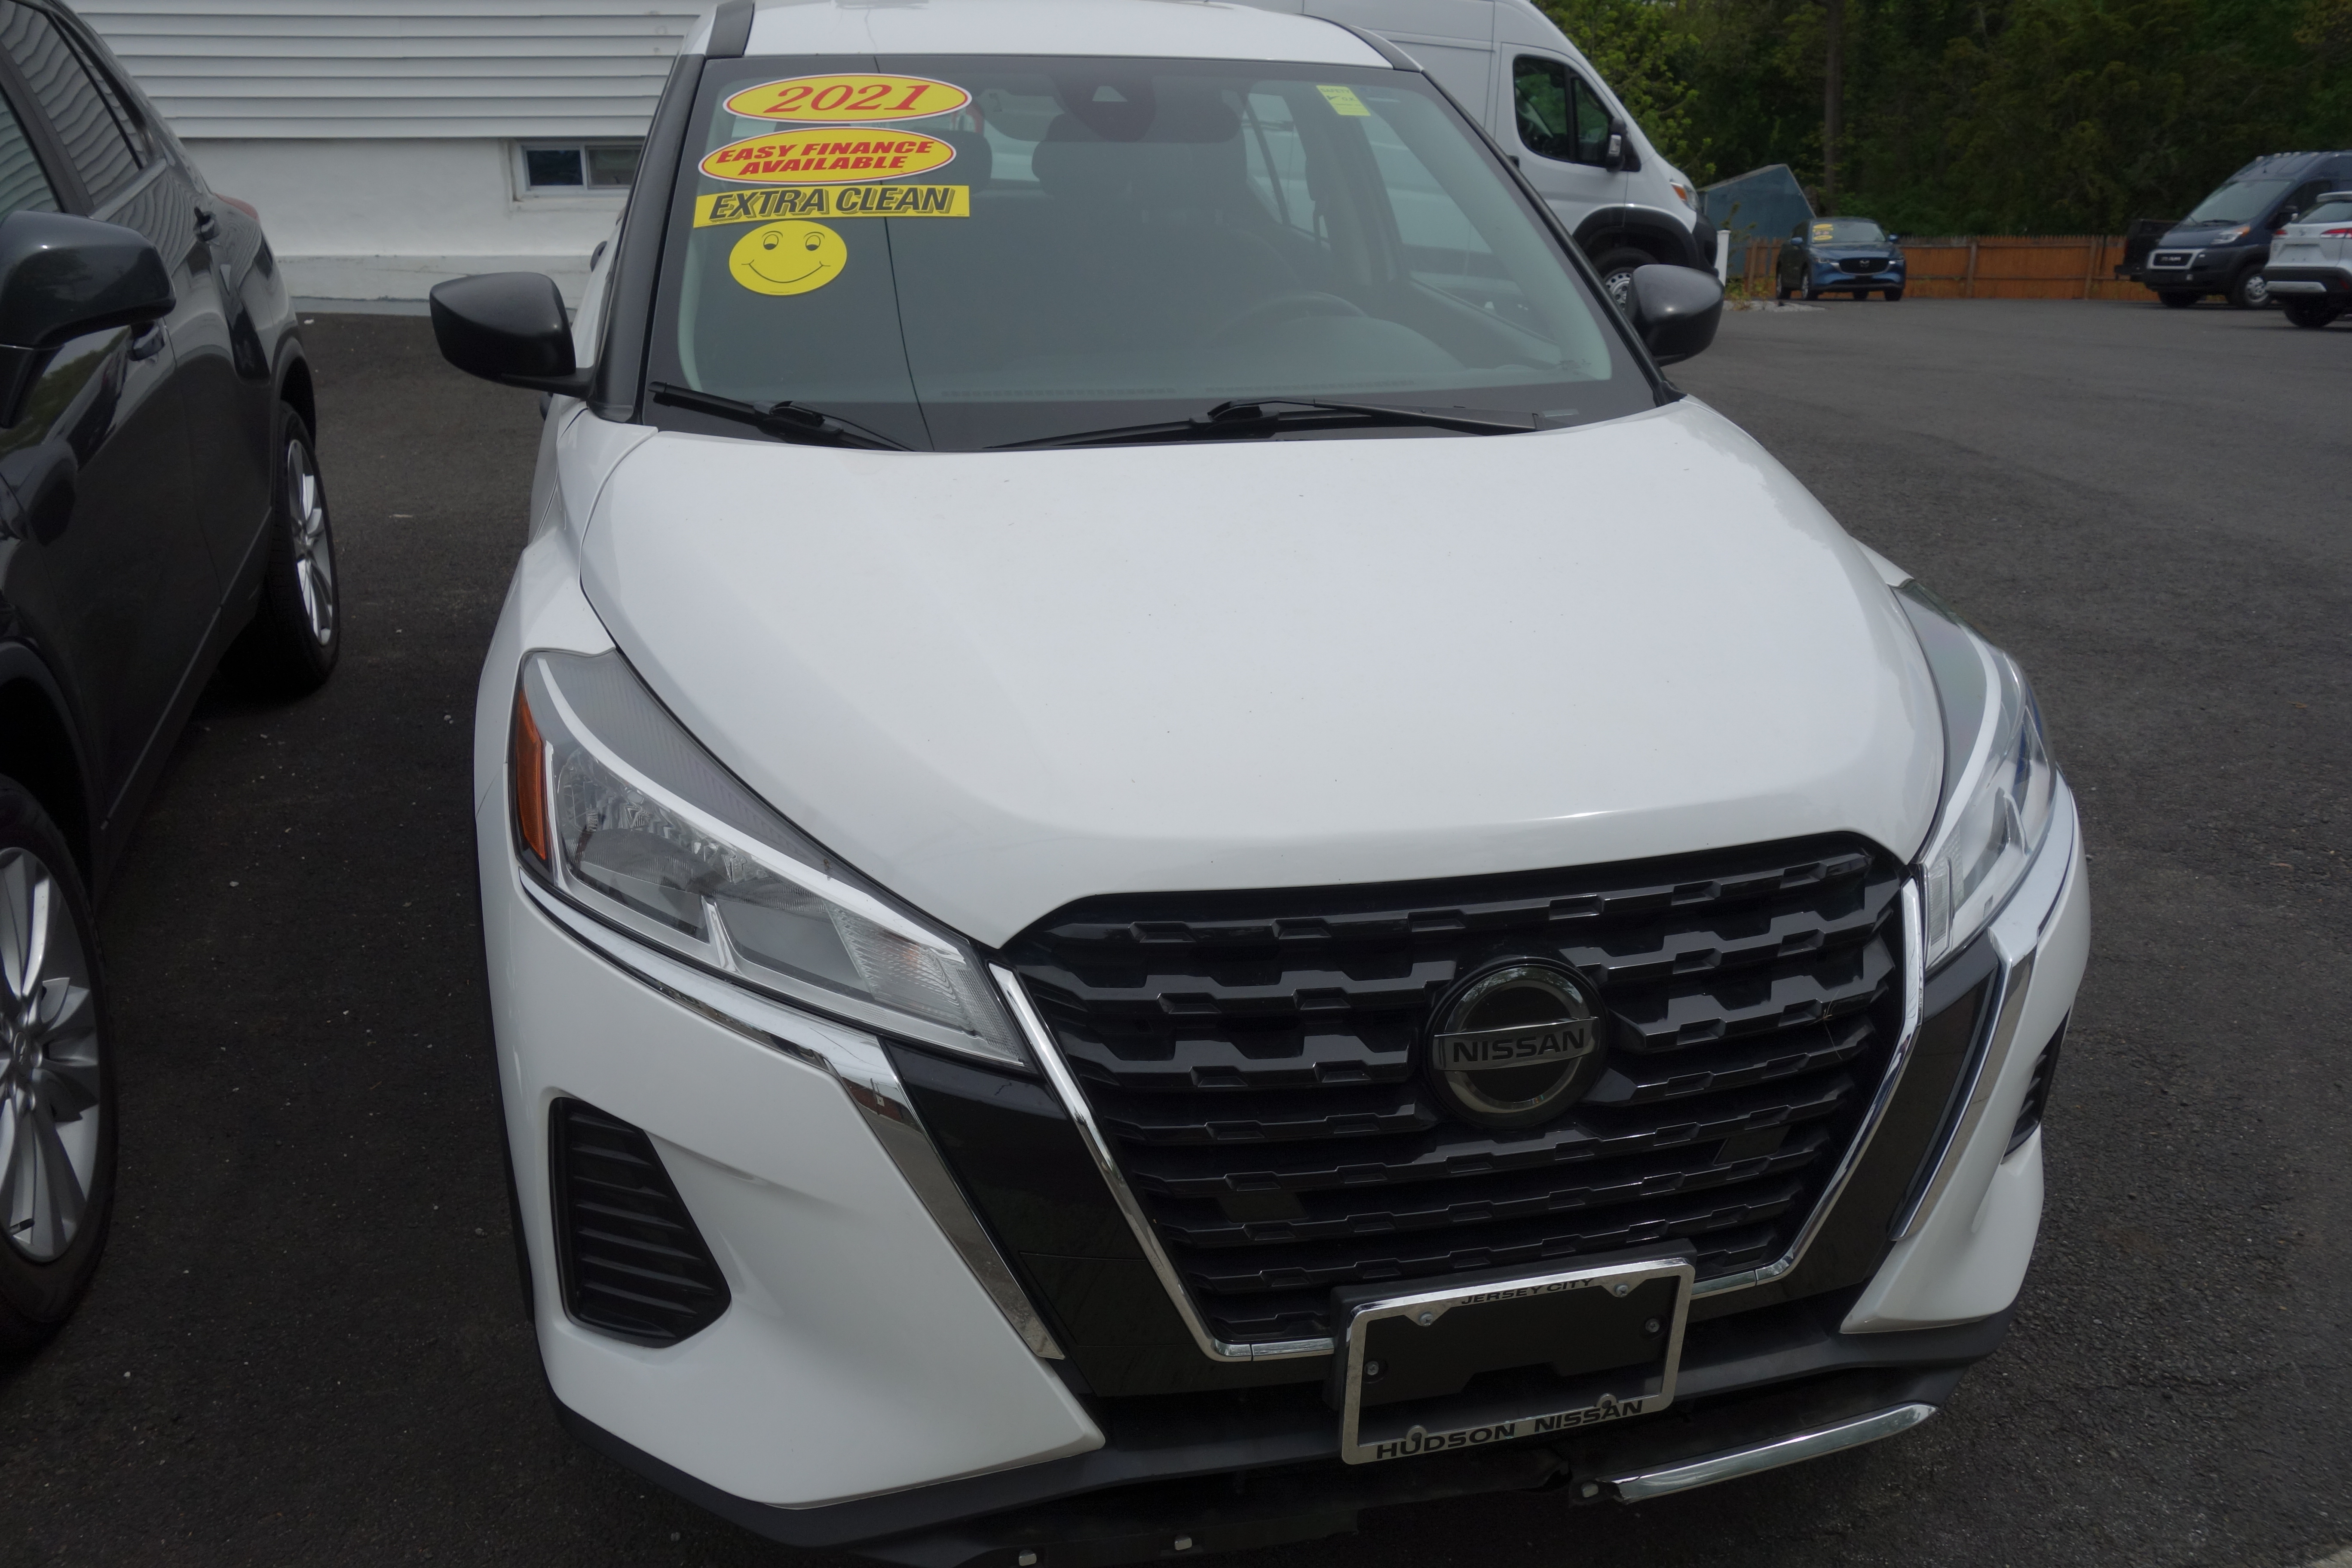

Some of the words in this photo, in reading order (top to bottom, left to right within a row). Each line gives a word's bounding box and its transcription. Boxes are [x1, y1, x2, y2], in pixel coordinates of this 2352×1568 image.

[763, 84, 931, 113] 2021
[715, 144, 798, 164] EASY
[800, 141, 935, 156] FINANCE
[738, 156, 908, 175] AVAILABLE
[708, 188, 829, 220] EXTRA
[836, 187, 955, 214] CLEAN
[1453, 1028, 1584, 1063] NISSAN
[1461, 1285, 1543, 1305] JERSEY
[1547, 1278, 1594, 1292] CITY
[1376, 1423, 1515, 1459] HUDSON
[1534, 1400, 1643, 1433] NISSAN
